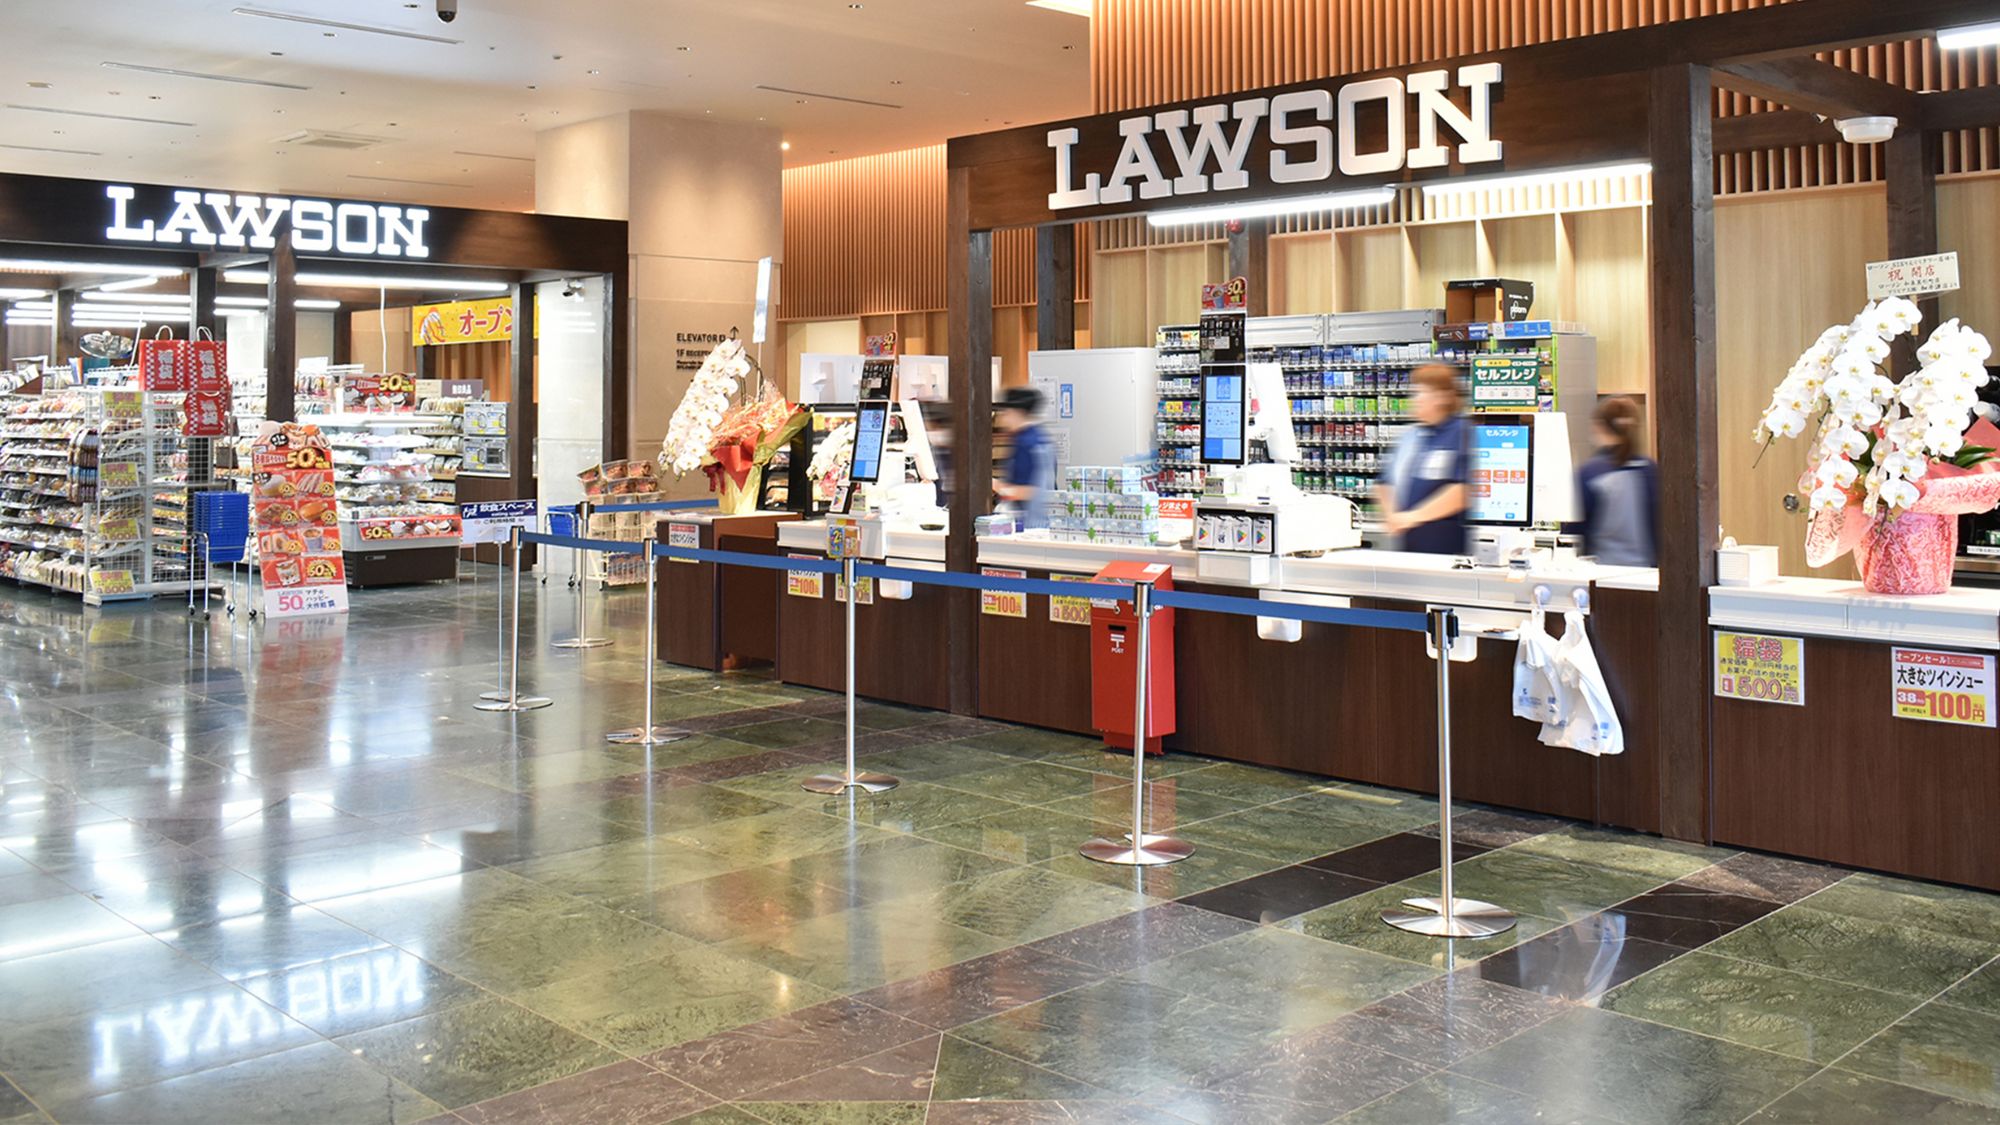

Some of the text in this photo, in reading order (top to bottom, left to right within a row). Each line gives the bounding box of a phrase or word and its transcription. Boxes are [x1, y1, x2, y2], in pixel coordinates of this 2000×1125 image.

[1048, 62, 1502, 210] LAWSON
[106, 186, 430, 258] LAWSON
[1509, 300, 1527, 319] ploom
[676, 333, 718, 343] ELEVATOR
[379, 374, 402, 391] 50
[1475, 368, 1537, 381] セルフレジ
[1486, 429, 1519, 437] セルフレジ
[286, 448, 316, 468] 50
[279, 595, 303, 611] 50
[1734, 636, 1783, 661] 福袋
[1896, 664, 1984, 689] 大きなツインシュー
